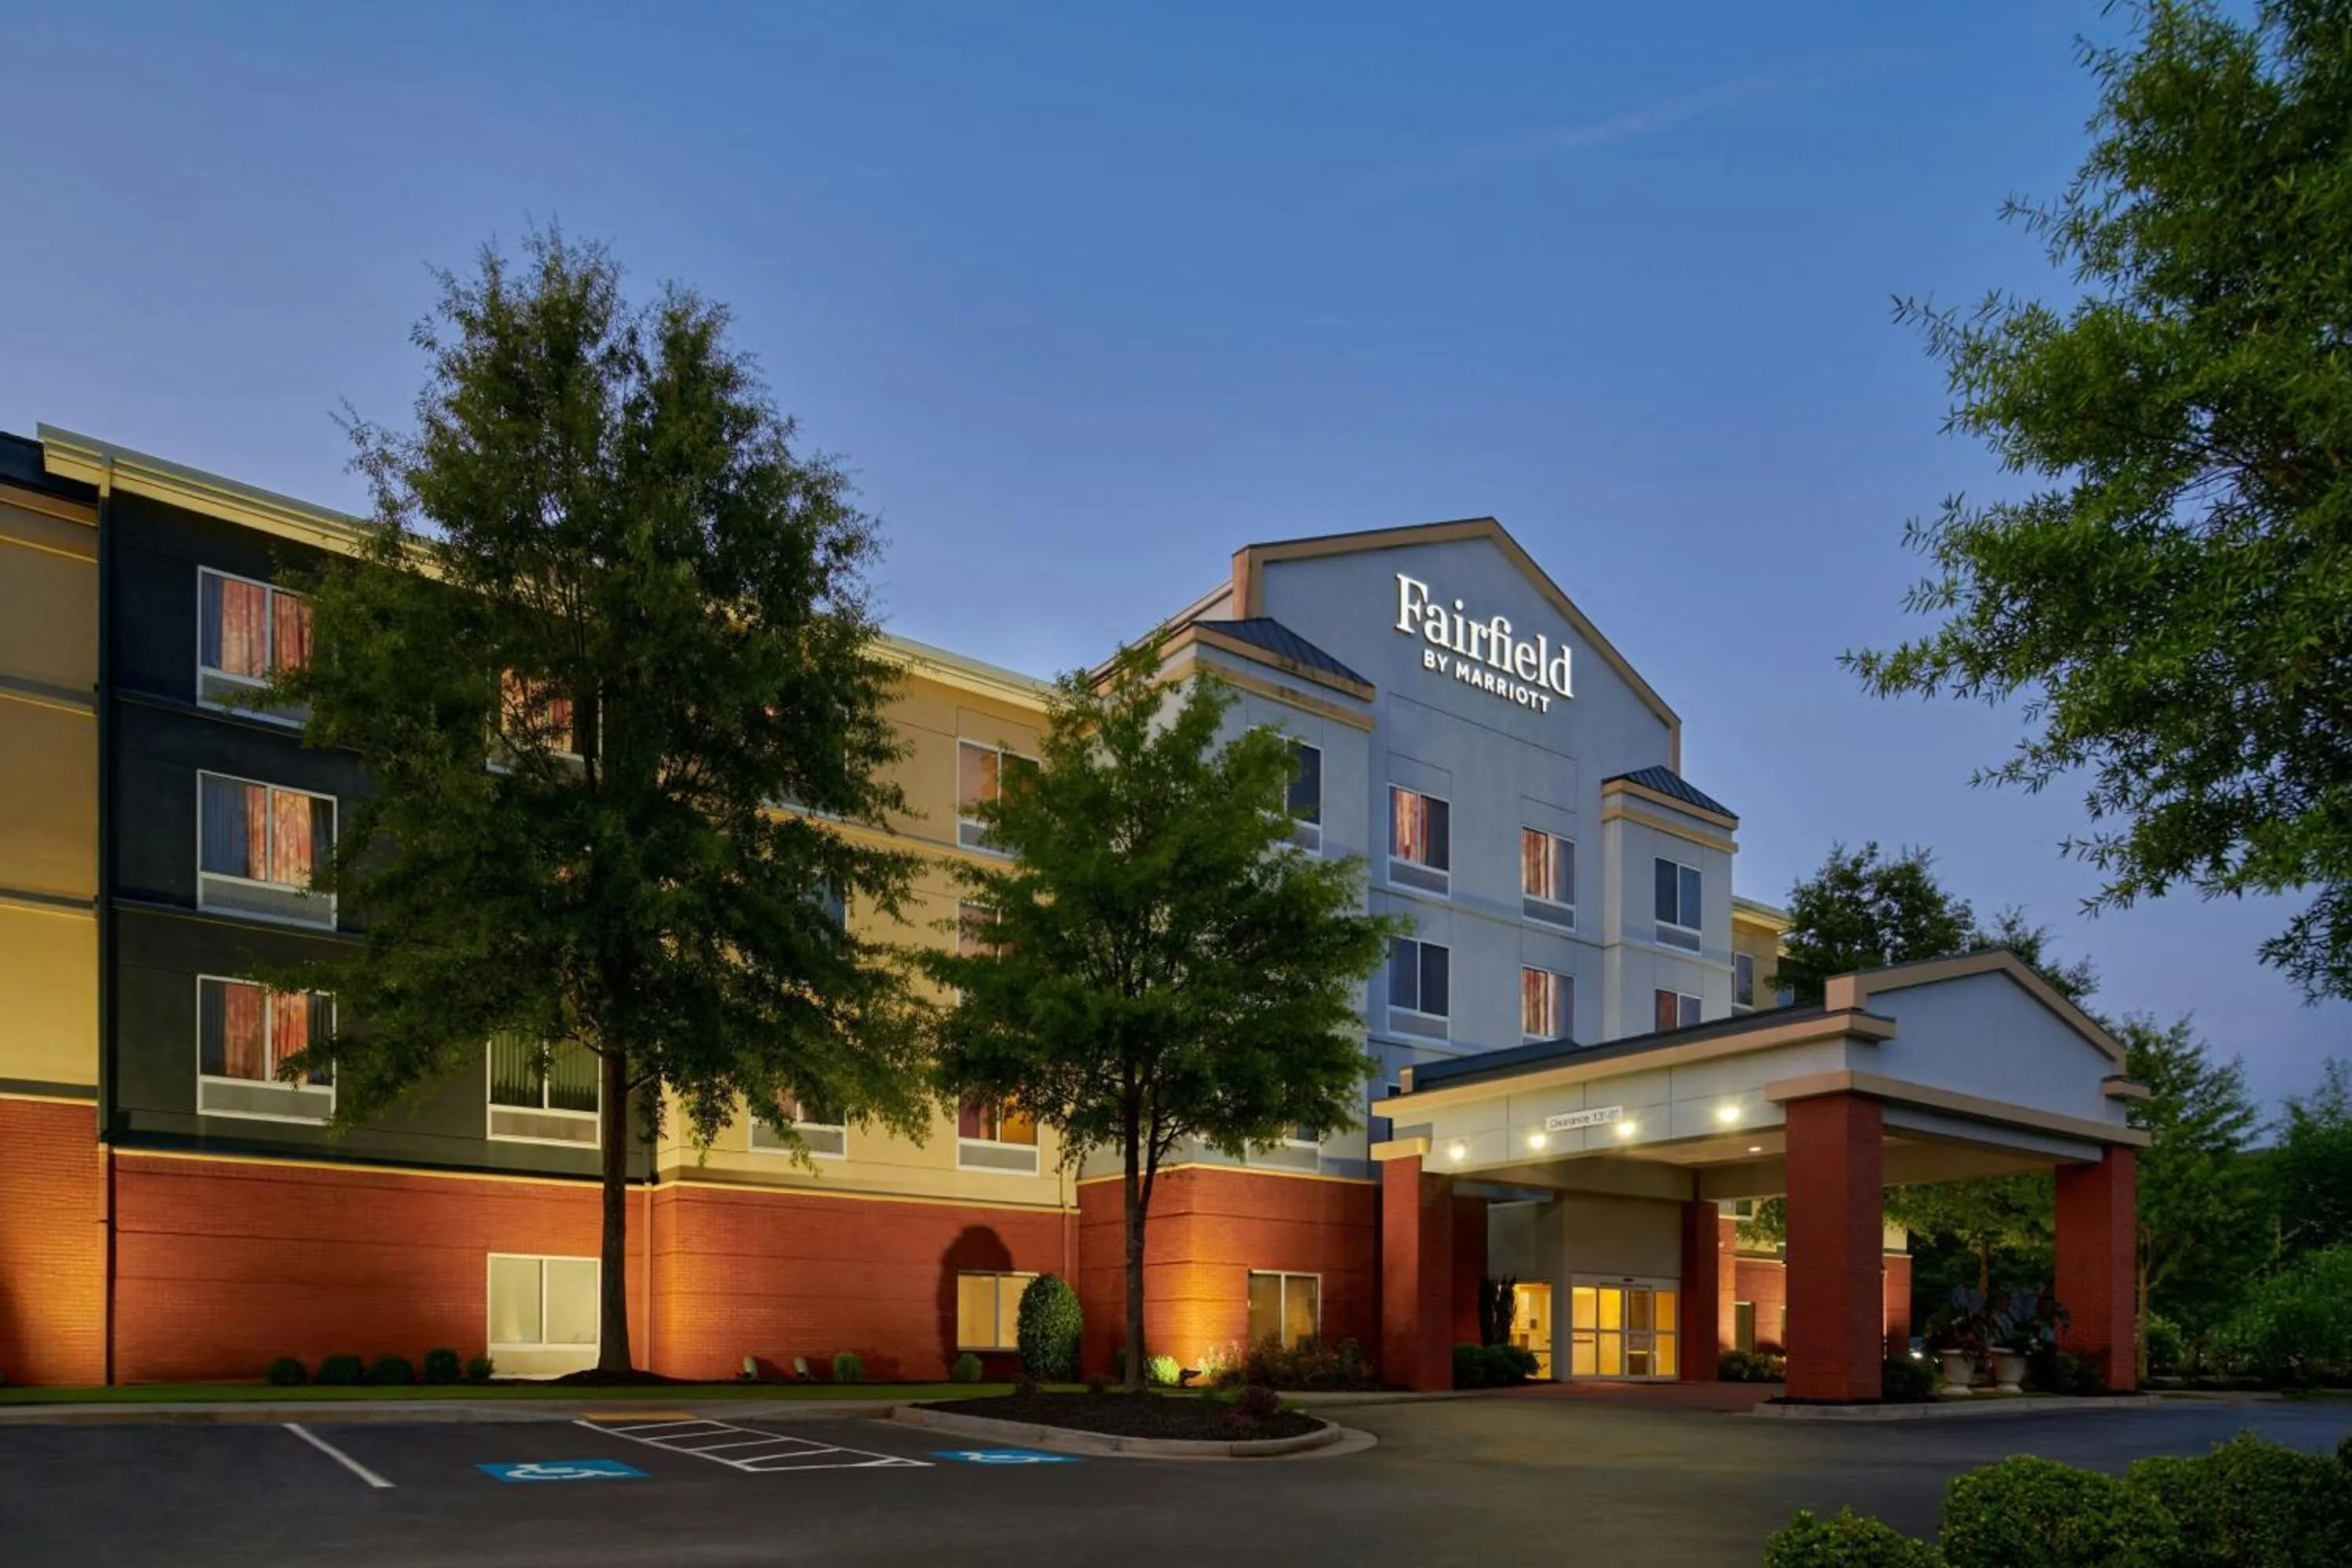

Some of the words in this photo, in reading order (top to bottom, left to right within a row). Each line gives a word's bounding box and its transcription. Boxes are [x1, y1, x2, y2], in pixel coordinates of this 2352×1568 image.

[1396, 573, 1574, 699] Fairfield
[1423, 650, 1449, 672] BY
[1455, 662, 1550, 713] MARRIOTT
